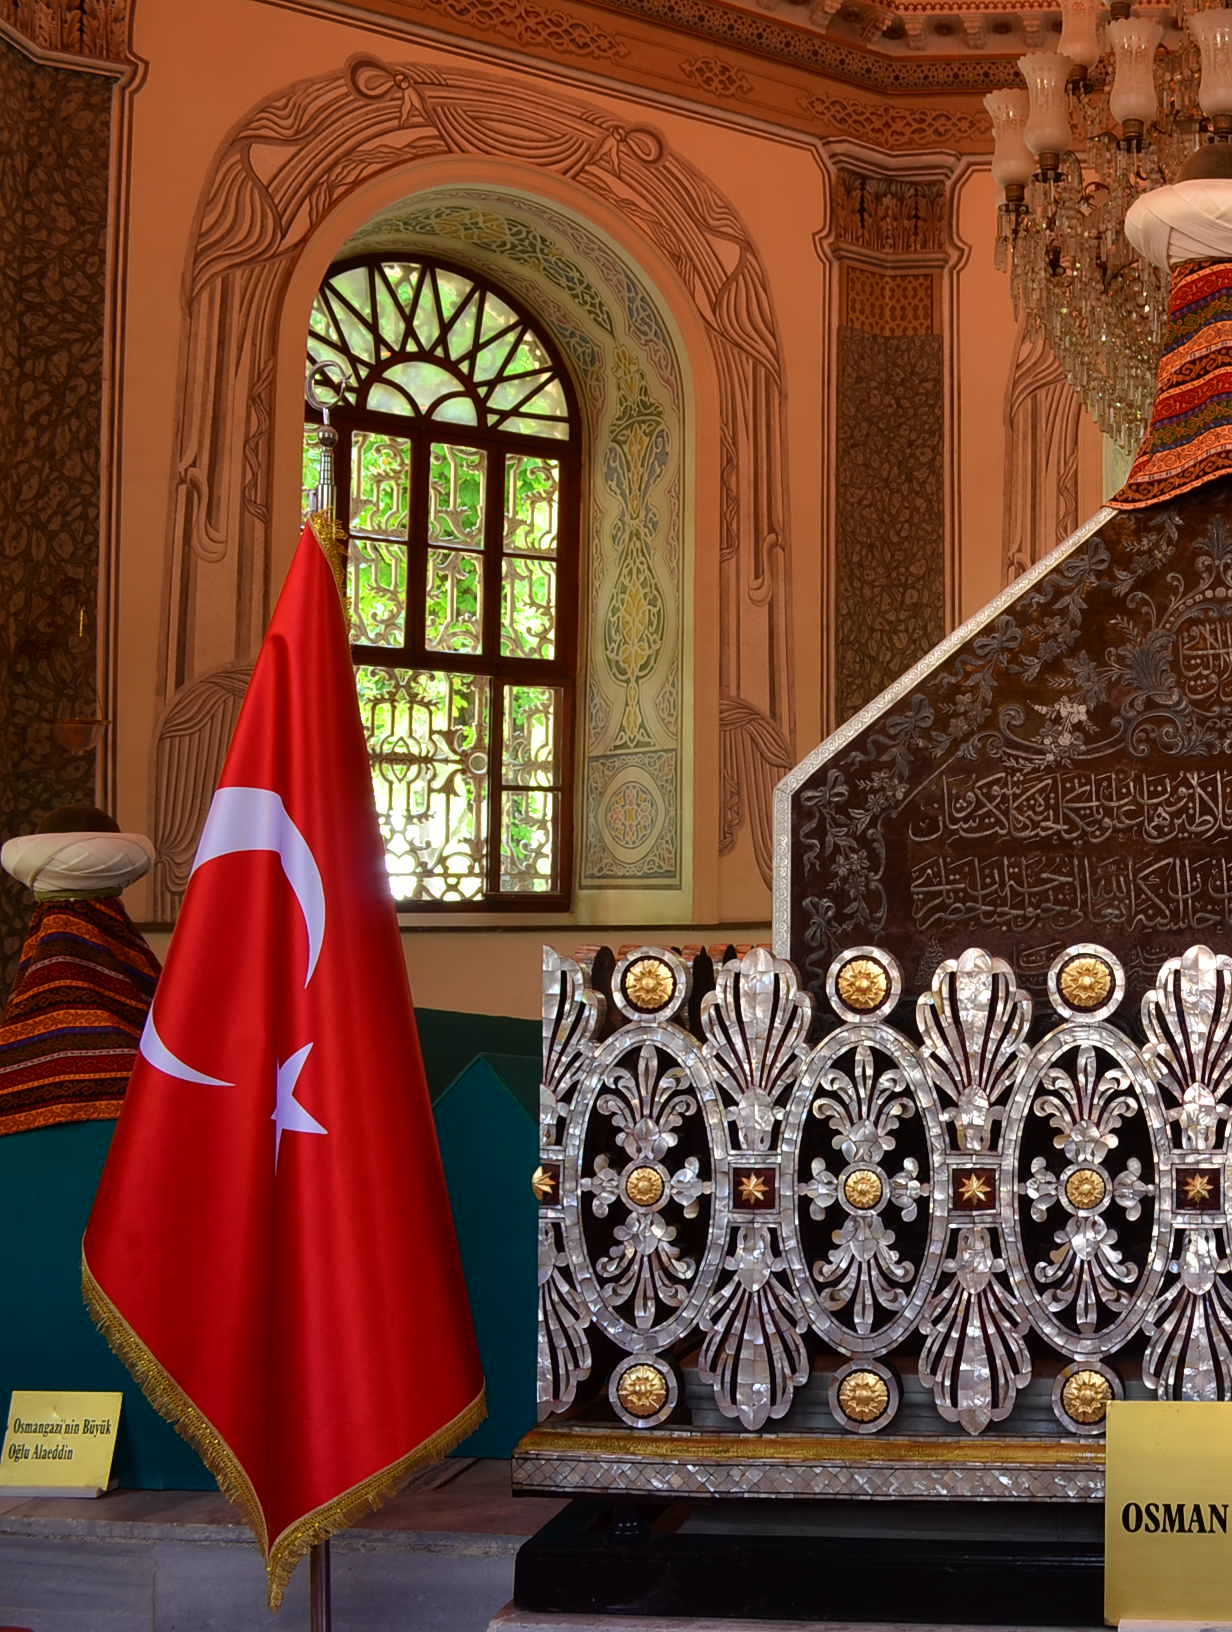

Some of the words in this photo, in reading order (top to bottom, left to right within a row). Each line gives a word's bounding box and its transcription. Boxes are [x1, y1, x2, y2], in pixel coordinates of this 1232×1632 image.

[82, 1417, 112, 1438] Büyük
[7, 1442, 30, 1463] Oğlu
[32, 1443, 74, 1461] Alaeddin
[1121, 1502, 1229, 1534] OSMAN
